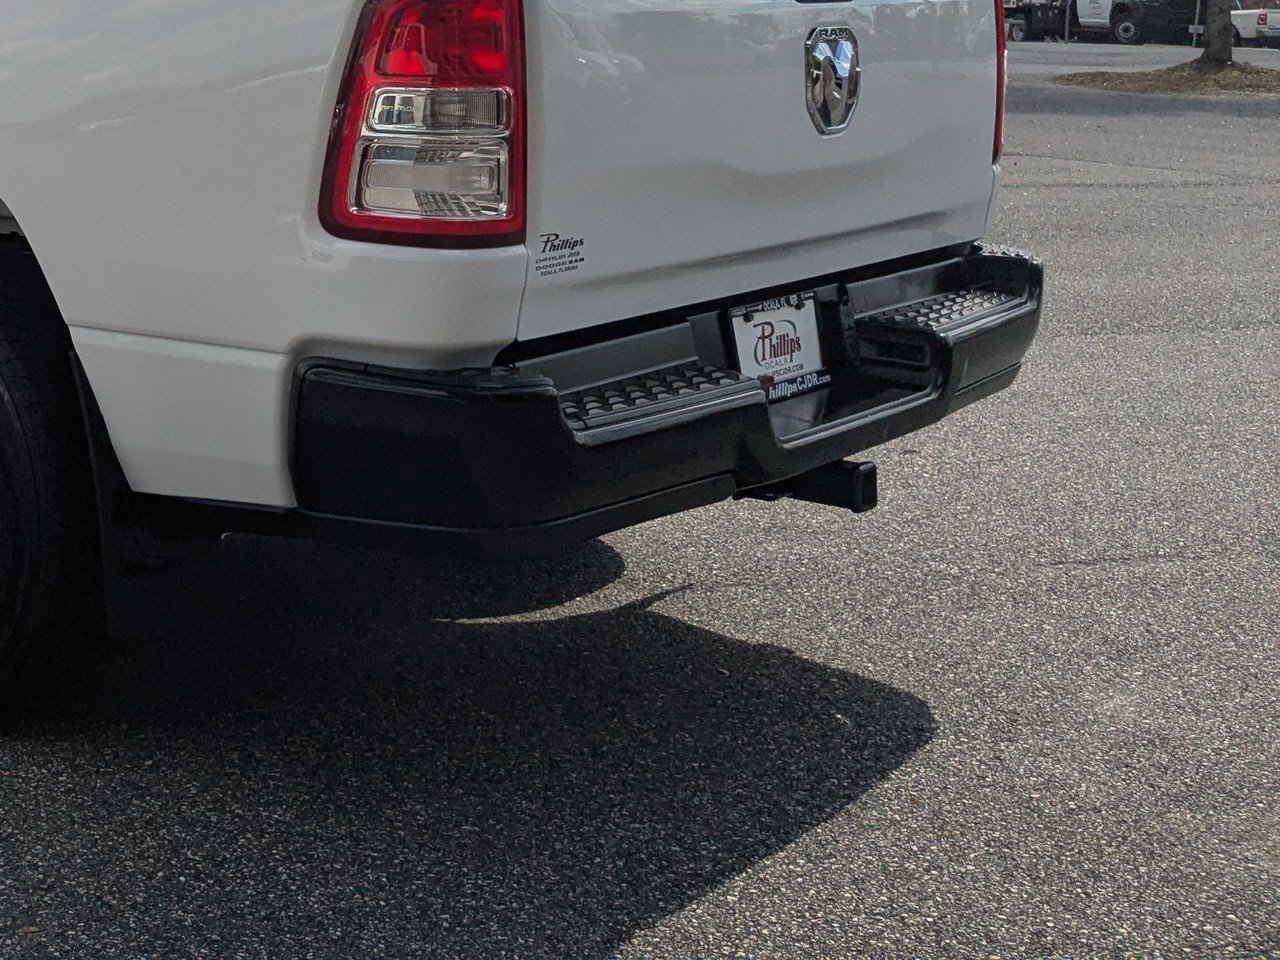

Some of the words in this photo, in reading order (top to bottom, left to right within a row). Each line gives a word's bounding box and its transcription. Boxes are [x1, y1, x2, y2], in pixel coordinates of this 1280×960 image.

[819, 27, 849, 38] RAM
[539, 233, 584, 253] Phillips
[535, 255, 566, 263] CHRYSLER
[535, 260, 567, 271] DODGE
[752, 321, 802, 362] Phillips
[765, 357, 789, 370] OCALA
[768, 373, 831, 399] hillipsCJDR.com
